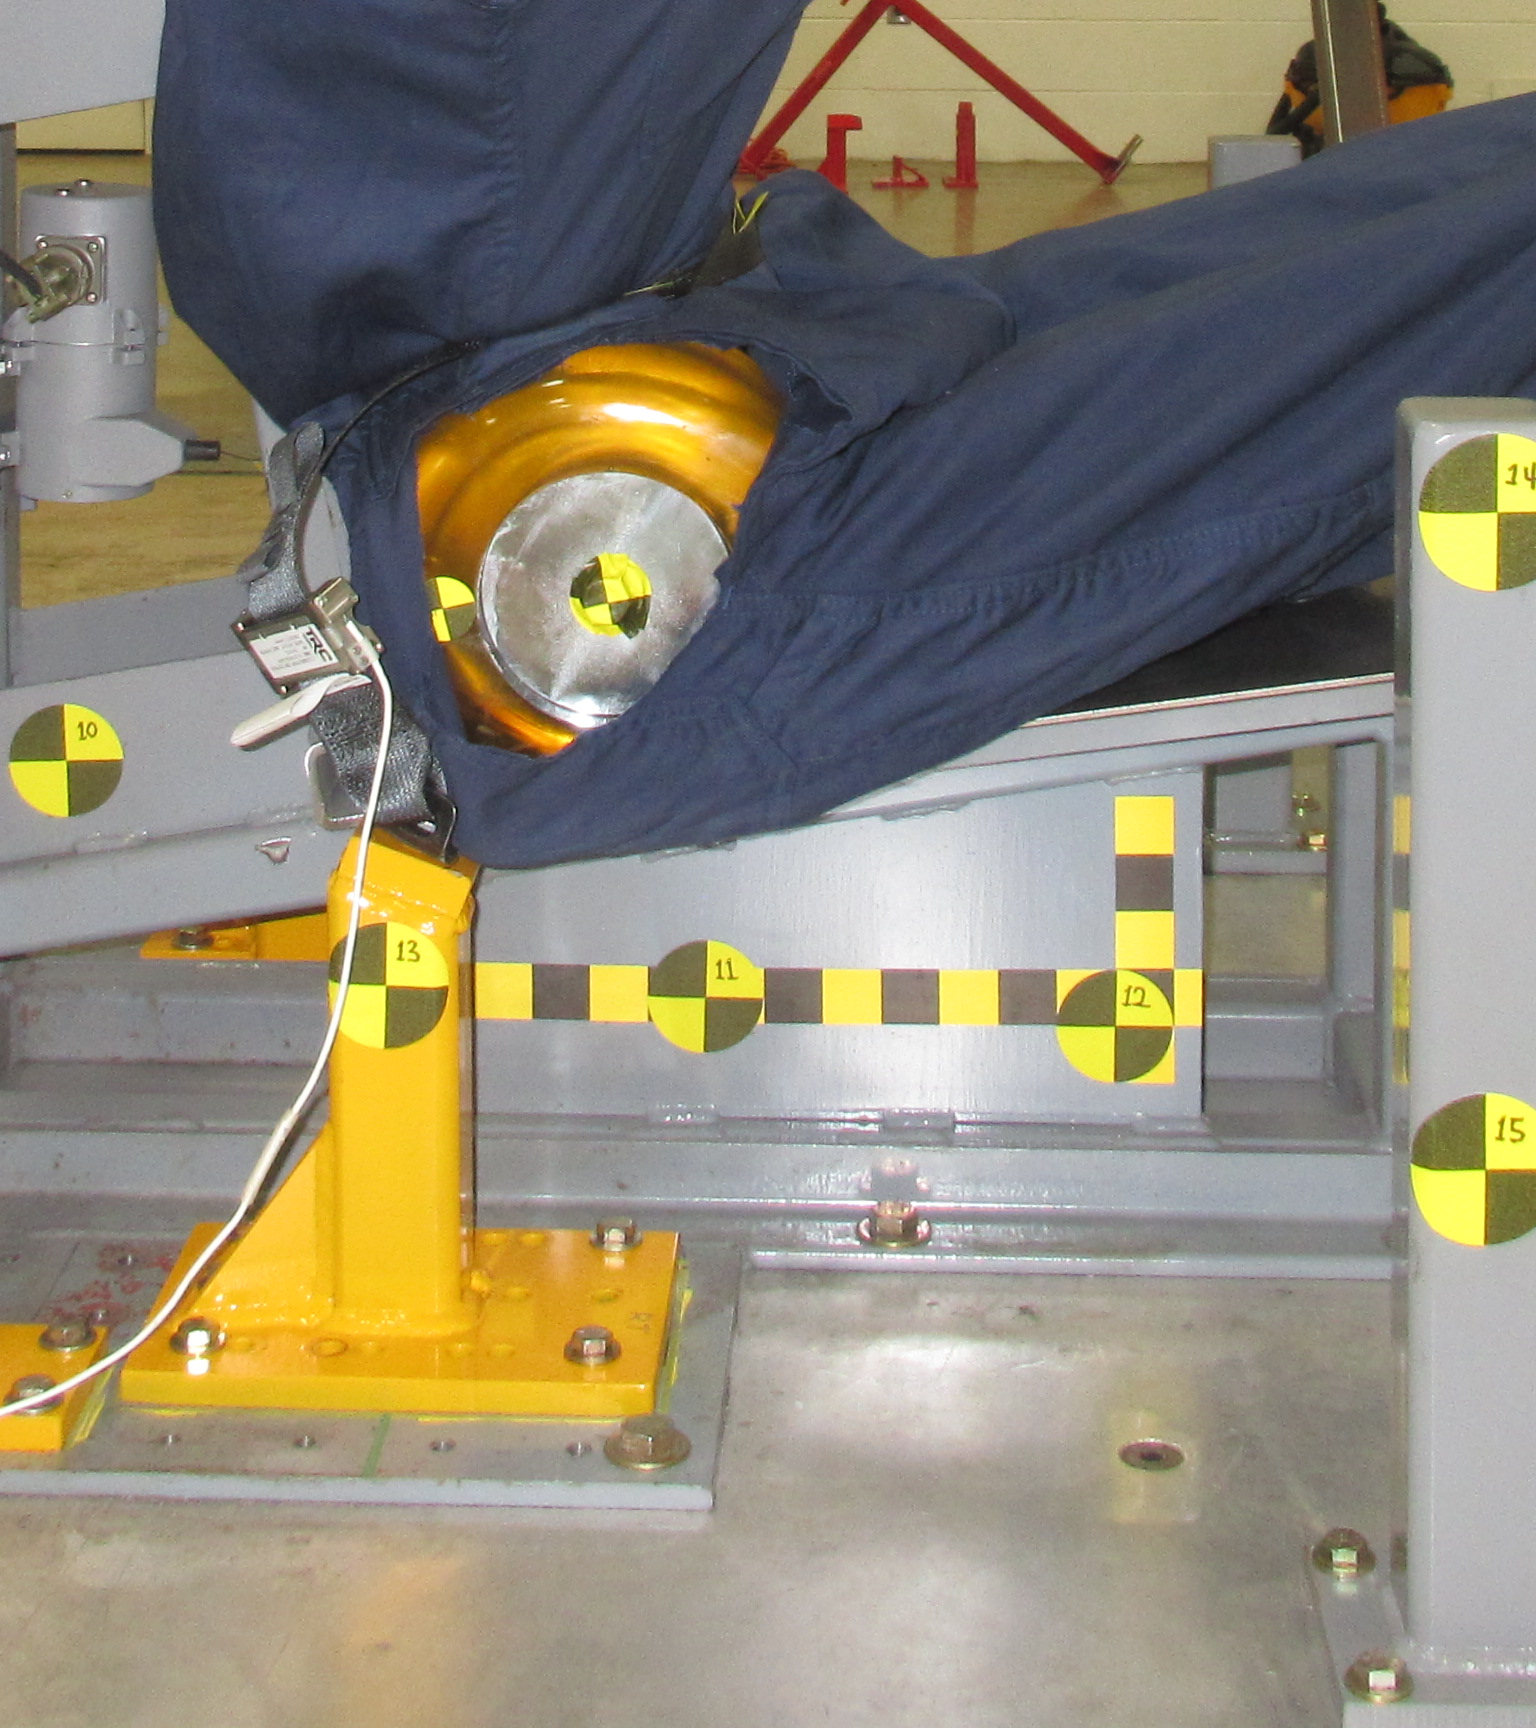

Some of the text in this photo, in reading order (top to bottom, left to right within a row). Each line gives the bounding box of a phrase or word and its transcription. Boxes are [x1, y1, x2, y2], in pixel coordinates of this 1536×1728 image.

[77, 721, 99, 742] 10
[396, 940, 421, 963] 13
[715, 958, 739, 981] 11
[1122, 985, 1151, 1009] 12
[1495, 1115, 1526, 1144] 15
